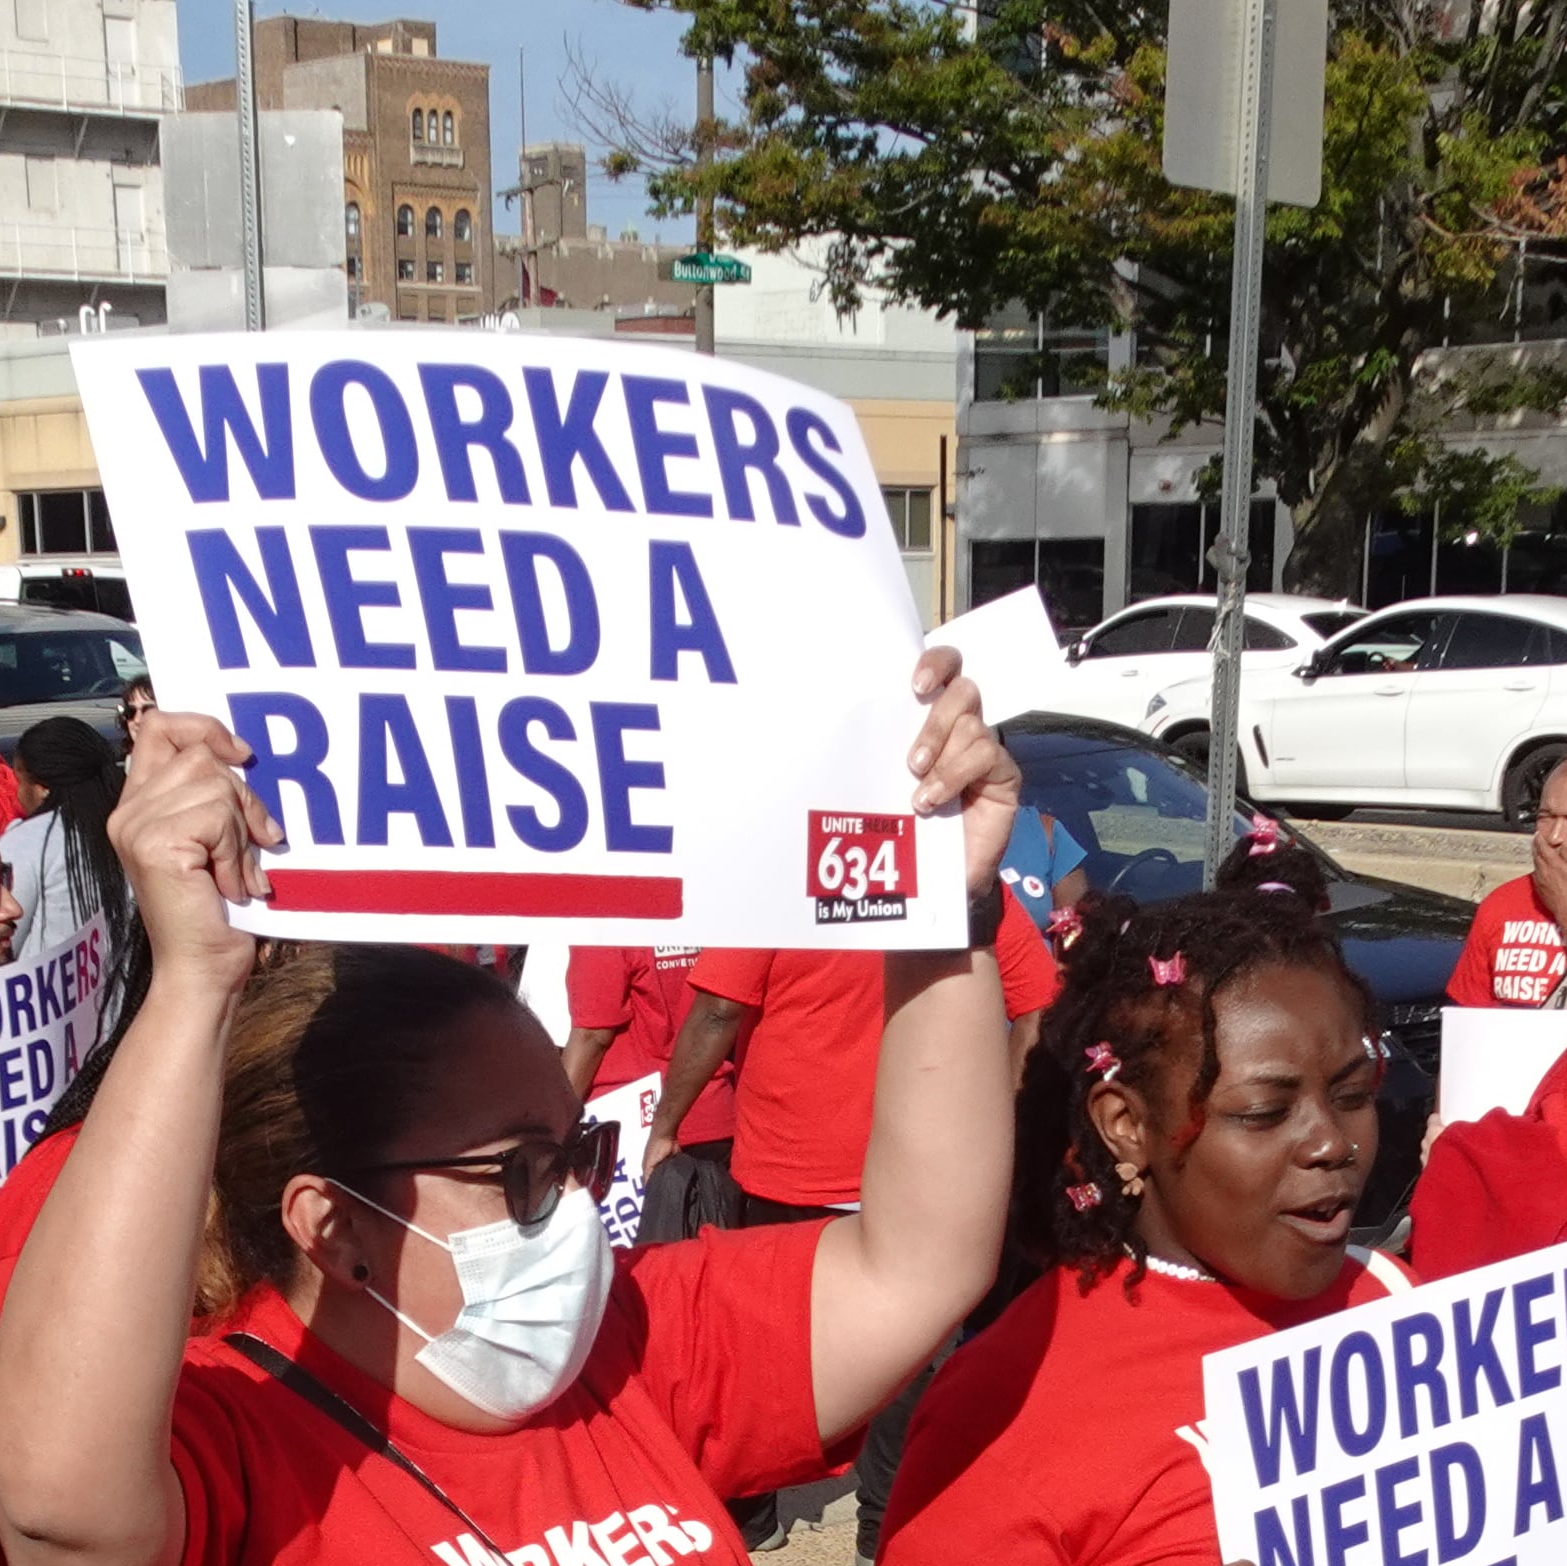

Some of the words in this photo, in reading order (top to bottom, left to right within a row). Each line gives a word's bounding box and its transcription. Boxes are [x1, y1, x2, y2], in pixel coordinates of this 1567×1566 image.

[136, 359, 867, 540] WORKERS
[185, 524, 600, 676] NEED
[648, 539, 738, 685] A
[226, 692, 674, 854] RAISE
[818, 837, 900, 900] 634
[818, 901, 830, 919] is
[832, 900, 855, 921] My
[857, 898, 903, 918] Union
[1494, 947, 1548, 973] NEED
[1548, 951, 1567, 976] A
[63, 1021, 80, 1086] A
[1513, 1411, 1565, 1538] A
